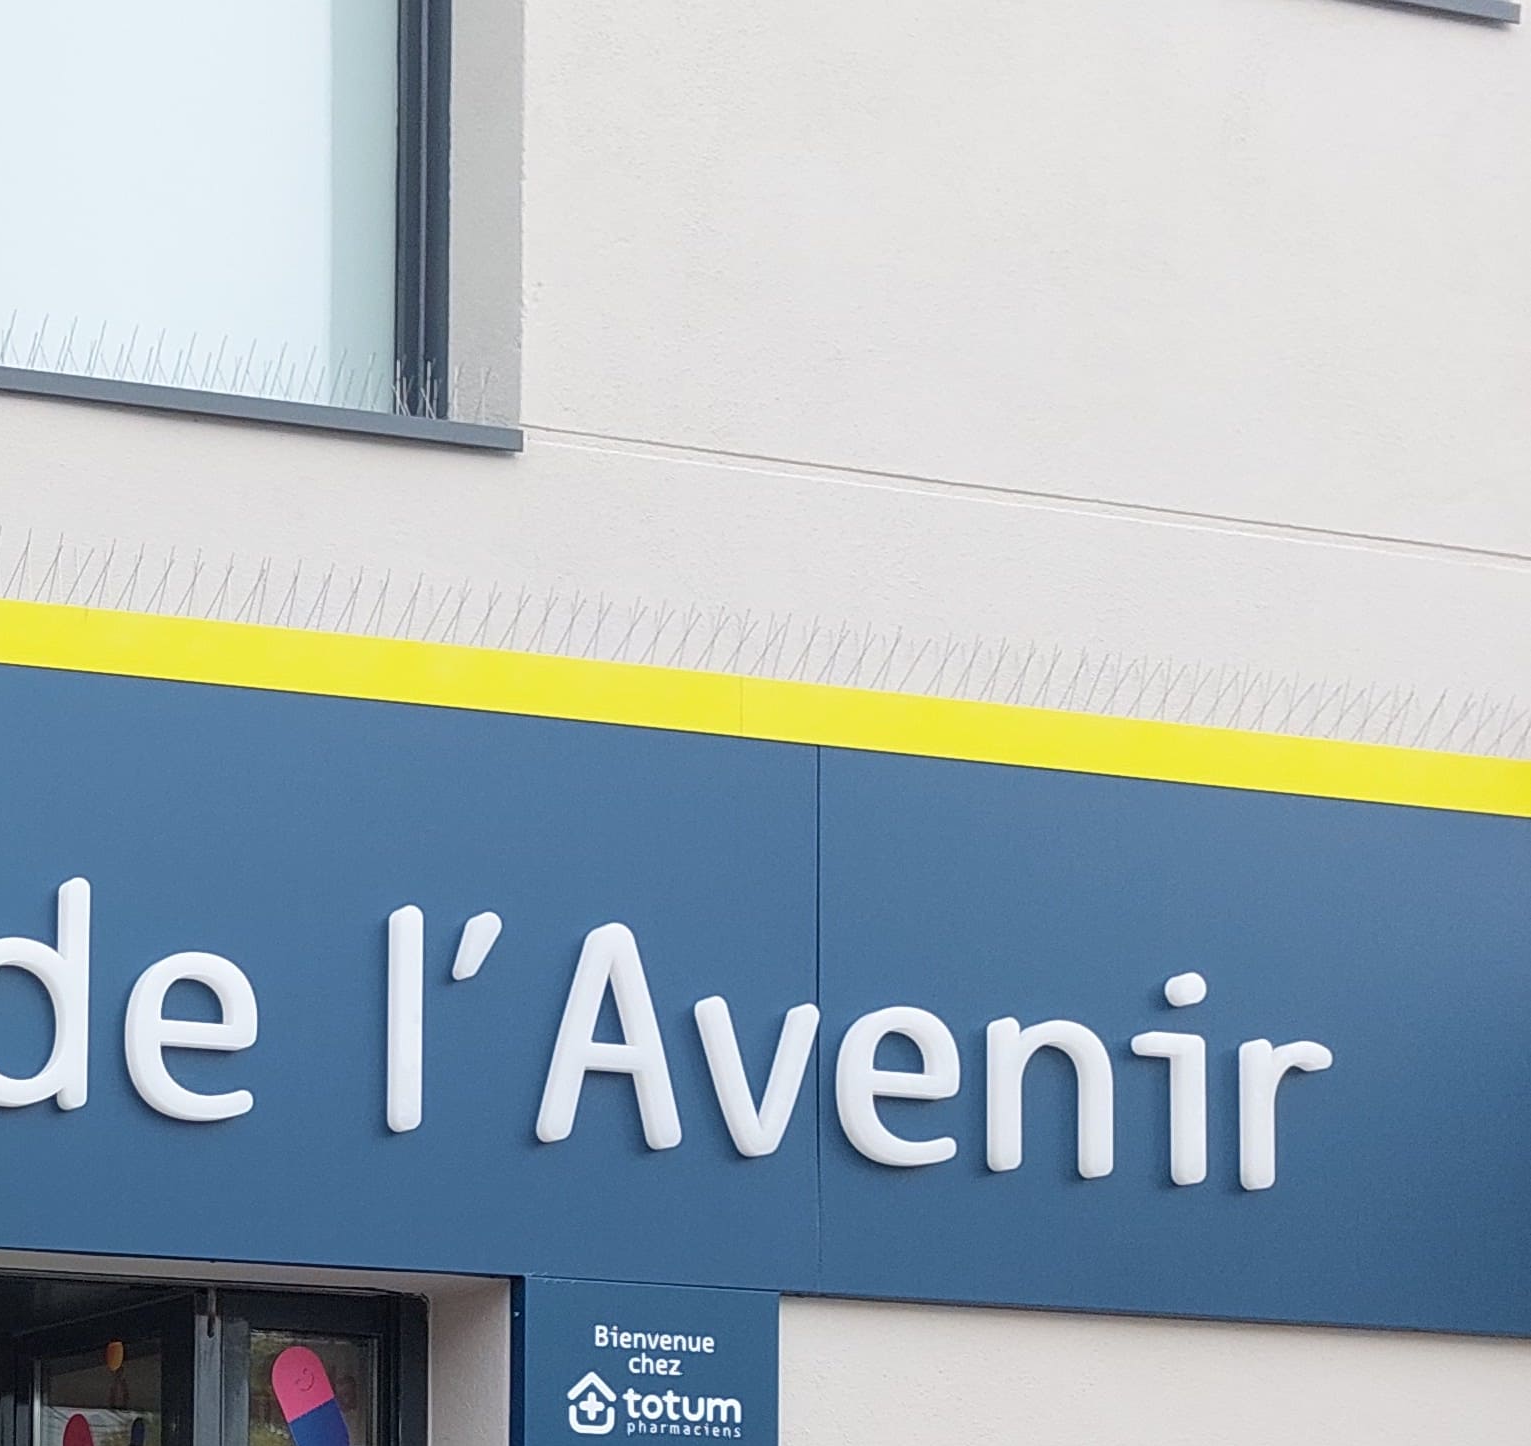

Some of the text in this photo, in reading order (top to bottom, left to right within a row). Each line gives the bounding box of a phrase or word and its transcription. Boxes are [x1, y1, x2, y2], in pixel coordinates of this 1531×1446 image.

[594, 1324, 715, 1354] Bienvenue
[628, 1353, 682, 1376] chez
[622, 1387, 742, 1424] totum
[626, 1420, 742, 1439] pharmaciens
